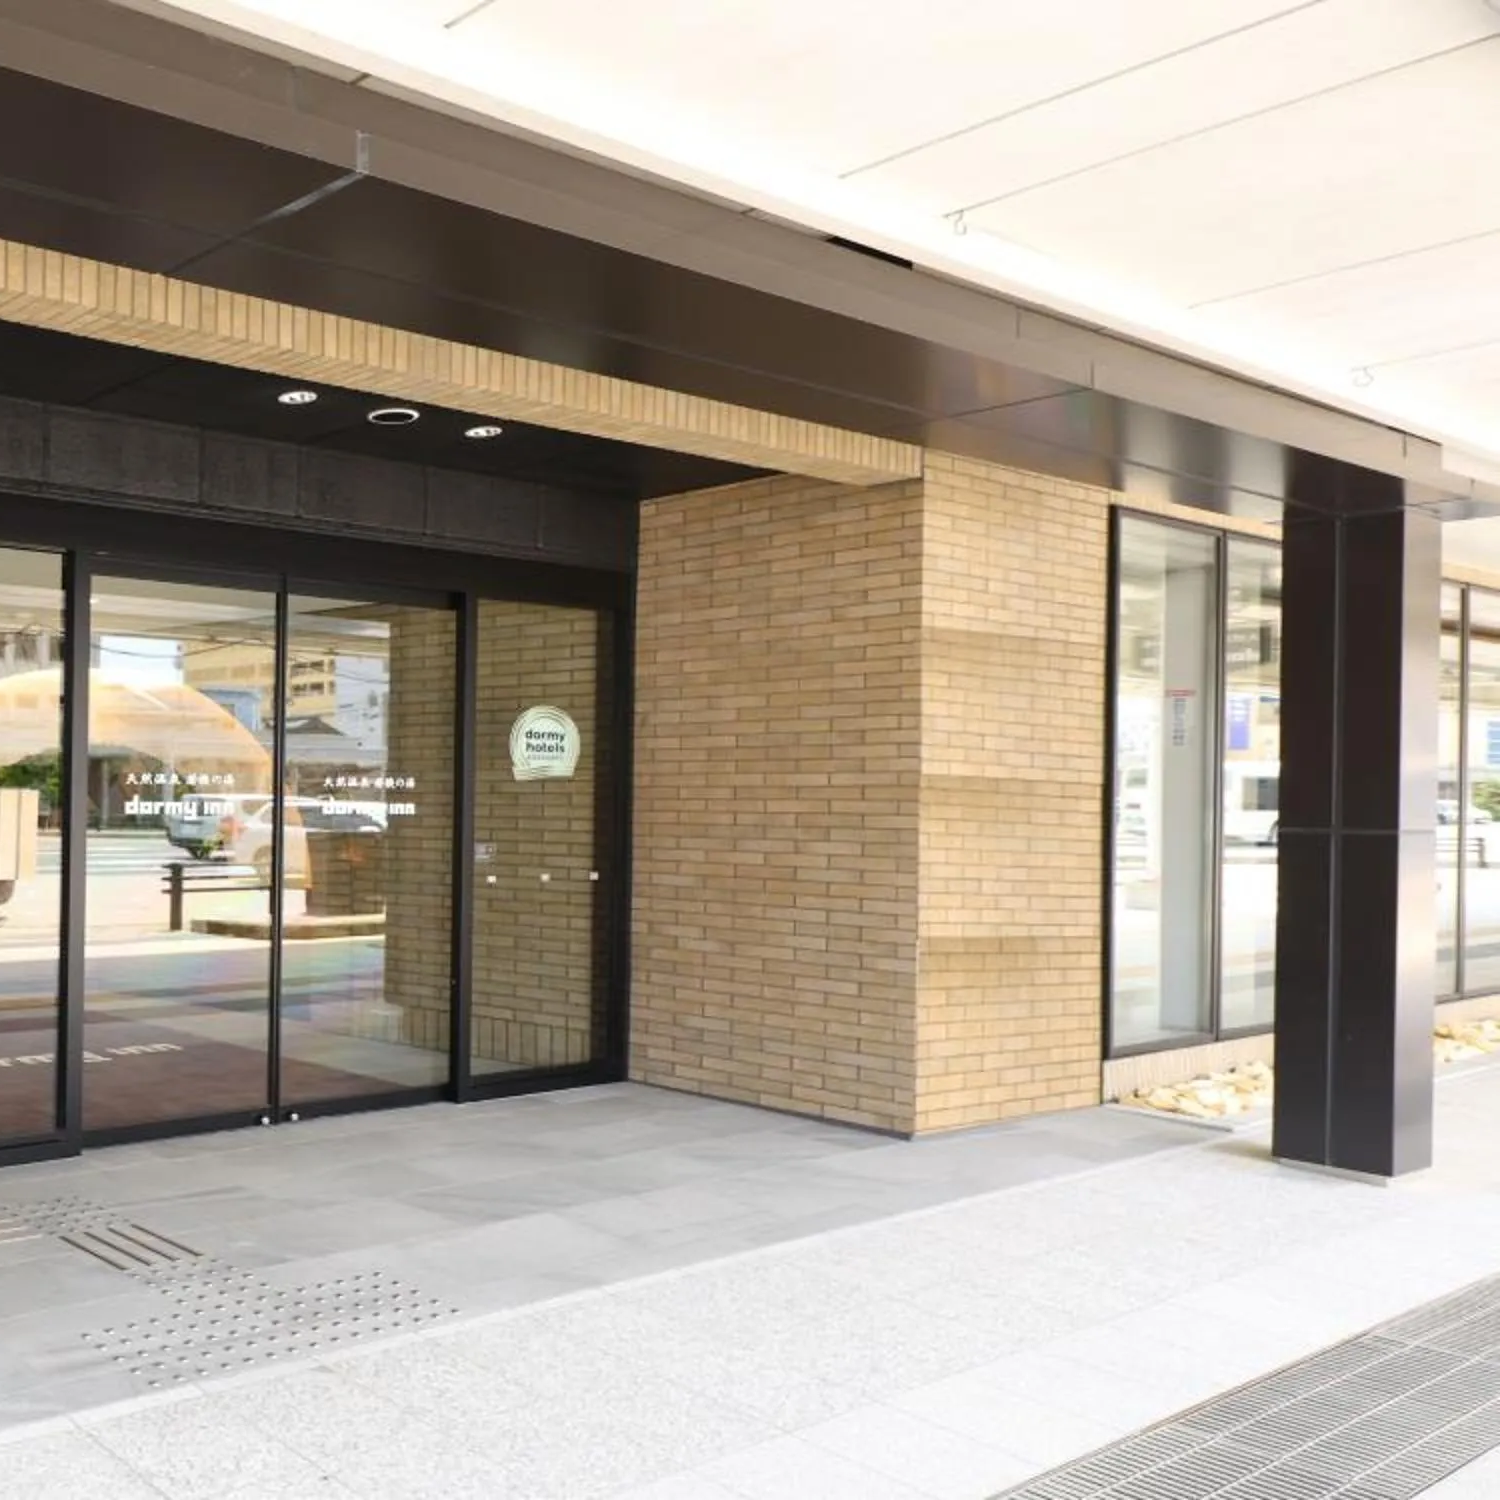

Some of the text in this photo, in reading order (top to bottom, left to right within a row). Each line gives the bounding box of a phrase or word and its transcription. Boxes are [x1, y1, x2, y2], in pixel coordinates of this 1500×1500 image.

[525, 729, 566, 743] dormy
[525, 742, 565, 752] hotels
[124, 794, 197, 820] dormy
[388, 802, 416, 815] inn
